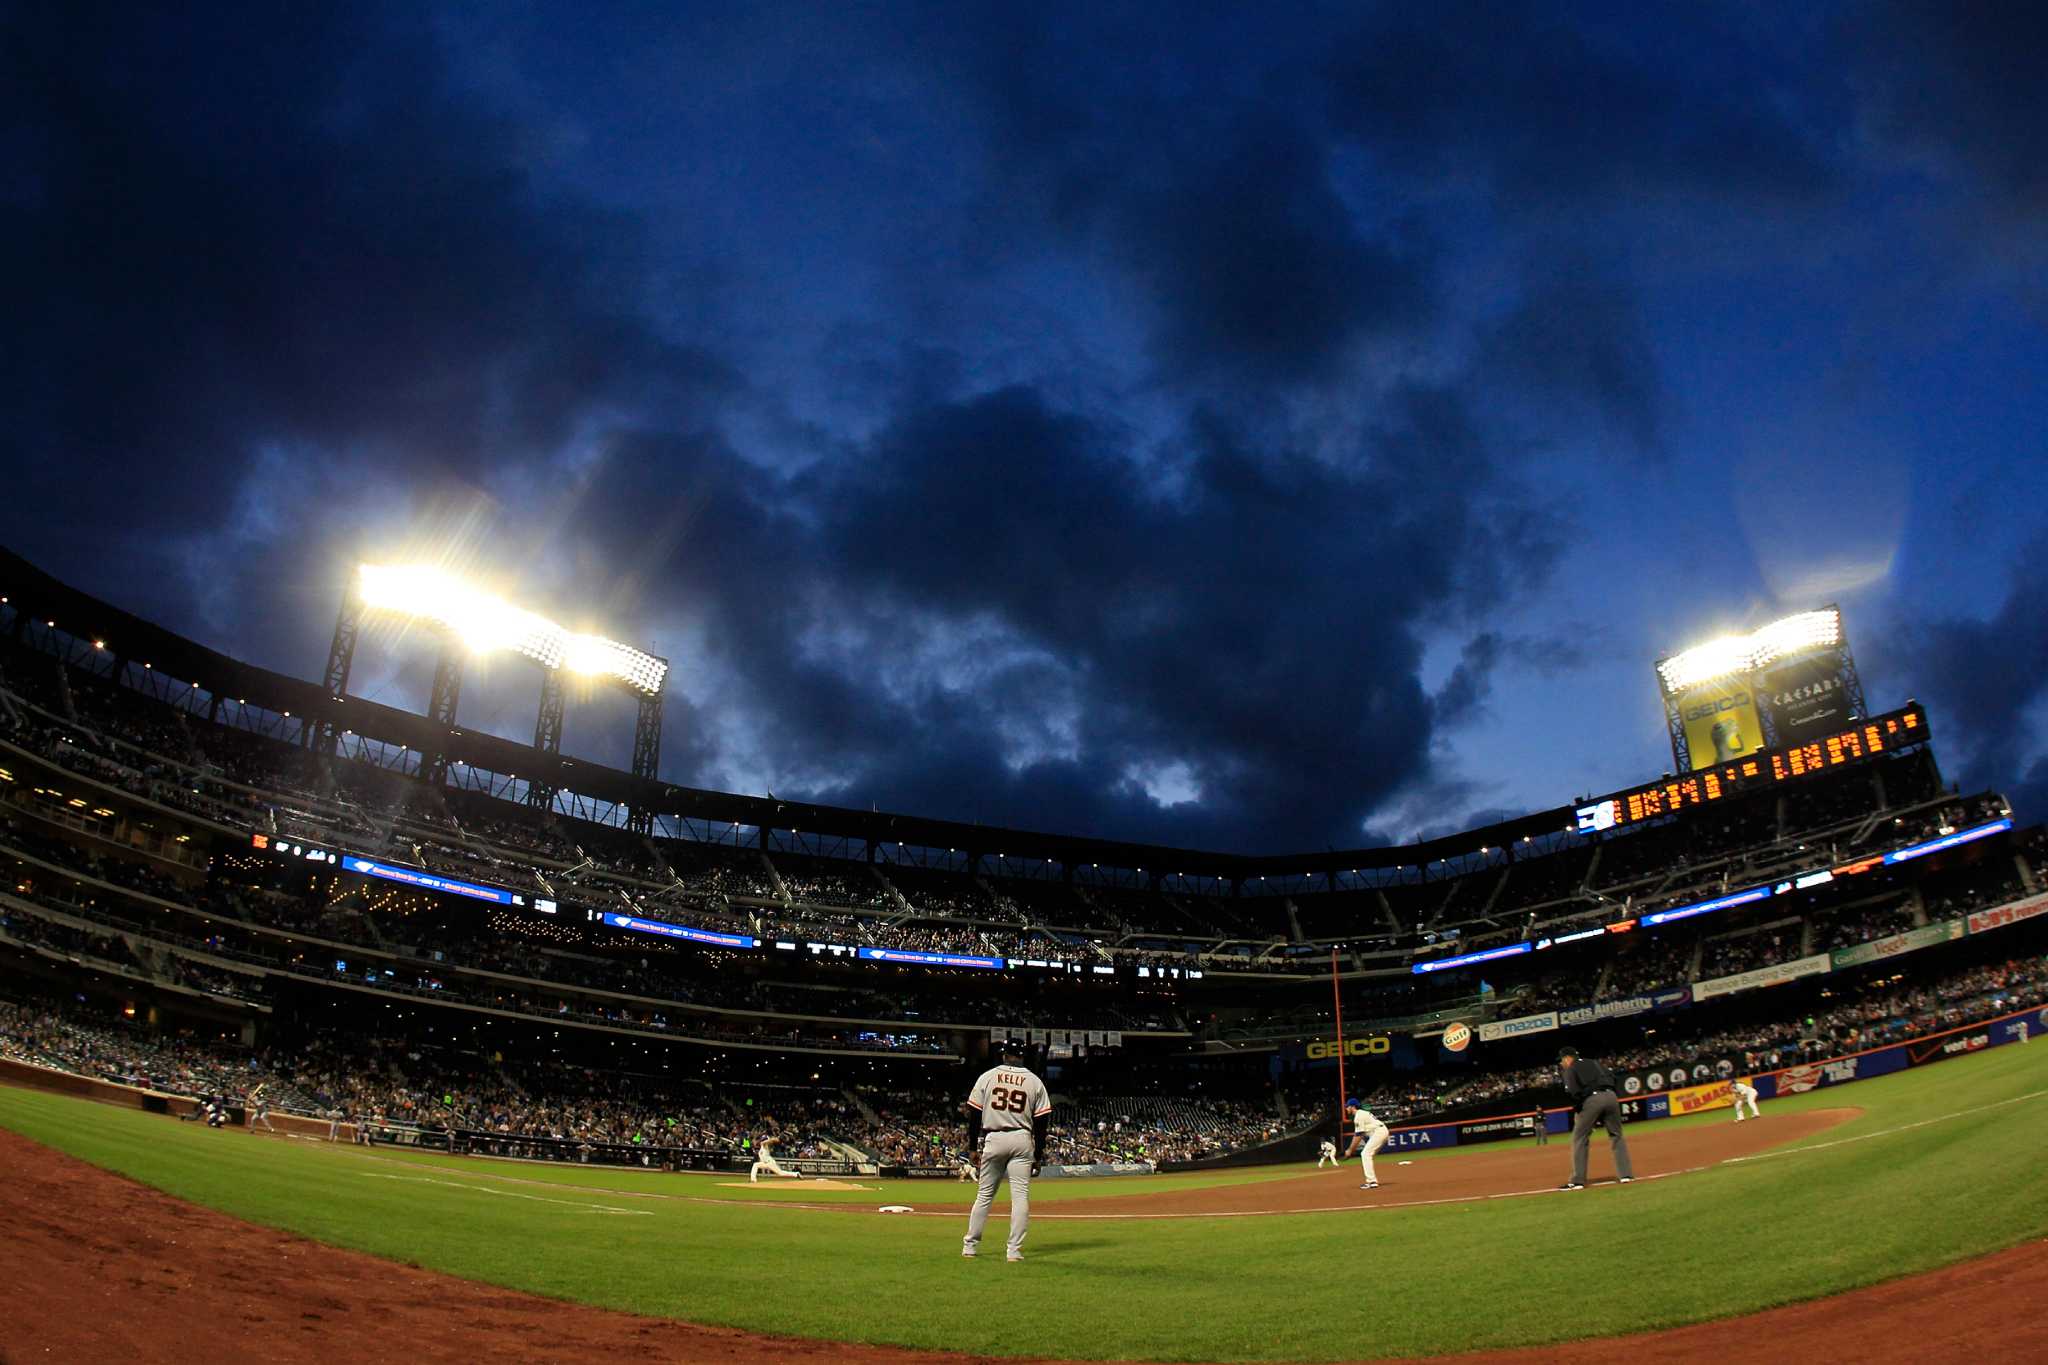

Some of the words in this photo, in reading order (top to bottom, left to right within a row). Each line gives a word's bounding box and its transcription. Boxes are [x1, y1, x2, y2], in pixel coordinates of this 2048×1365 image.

[1773, 675, 1842, 706] CAESARS
[1686, 691, 1750, 721] GEICO
[1560, 1006, 1593, 1025] Parts
[1594, 997, 1652, 1016] Authority
[1504, 1016, 1553, 1034] mazda
[1306, 1037, 1391, 1060] GEICO
[1445, 1029, 1468, 1045] Gulf
[997, 1073, 1026, 1087] KELLY
[991, 1086, 1028, 1114] 39
[1387, 1131, 1431, 1147] ELTA
